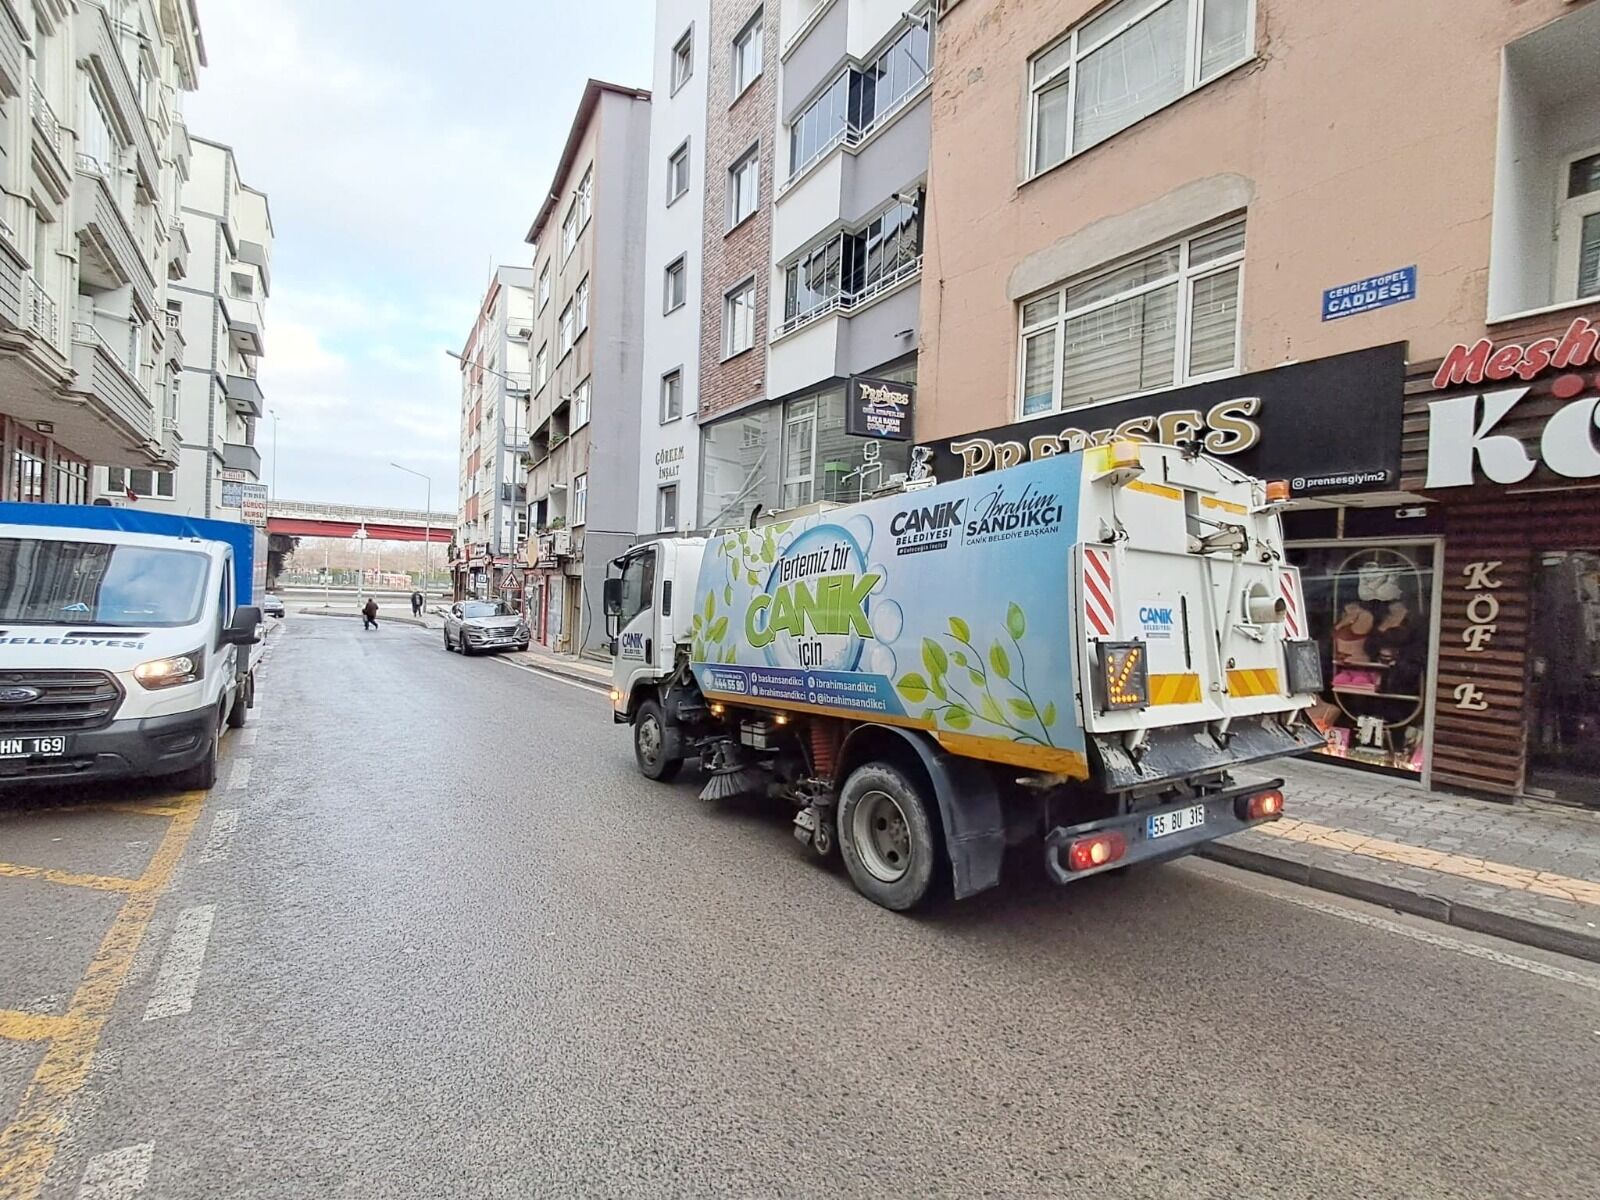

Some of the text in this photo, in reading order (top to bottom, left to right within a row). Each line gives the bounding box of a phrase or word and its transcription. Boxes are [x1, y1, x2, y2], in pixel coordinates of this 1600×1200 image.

[1328, 270, 1407, 299] CENGİZ TOPEL
[1328, 279, 1409, 312] CADDESİ
[1432, 317, 1600, 389] Meşh
[966, 505, 1063, 537] SANDIKÇI
[1023, 526, 1059, 537] BAŞKANI
[780, 542, 852, 583] Tertemiz bir
[798, 636, 822, 670] için
[714, 678, 728, 689] 444
[736, 680, 745, 691] 90
[758, 673, 804, 686] baskansandikci
[816, 678, 877, 694] ibrahimsandikci
[759, 686, 807, 700] ibrahimsandikci
[817, 692, 887, 710] @ibrahimsandikci
[33, 739, 62, 753] 169
[1154, 806, 1203, 835] 55 BU 315
